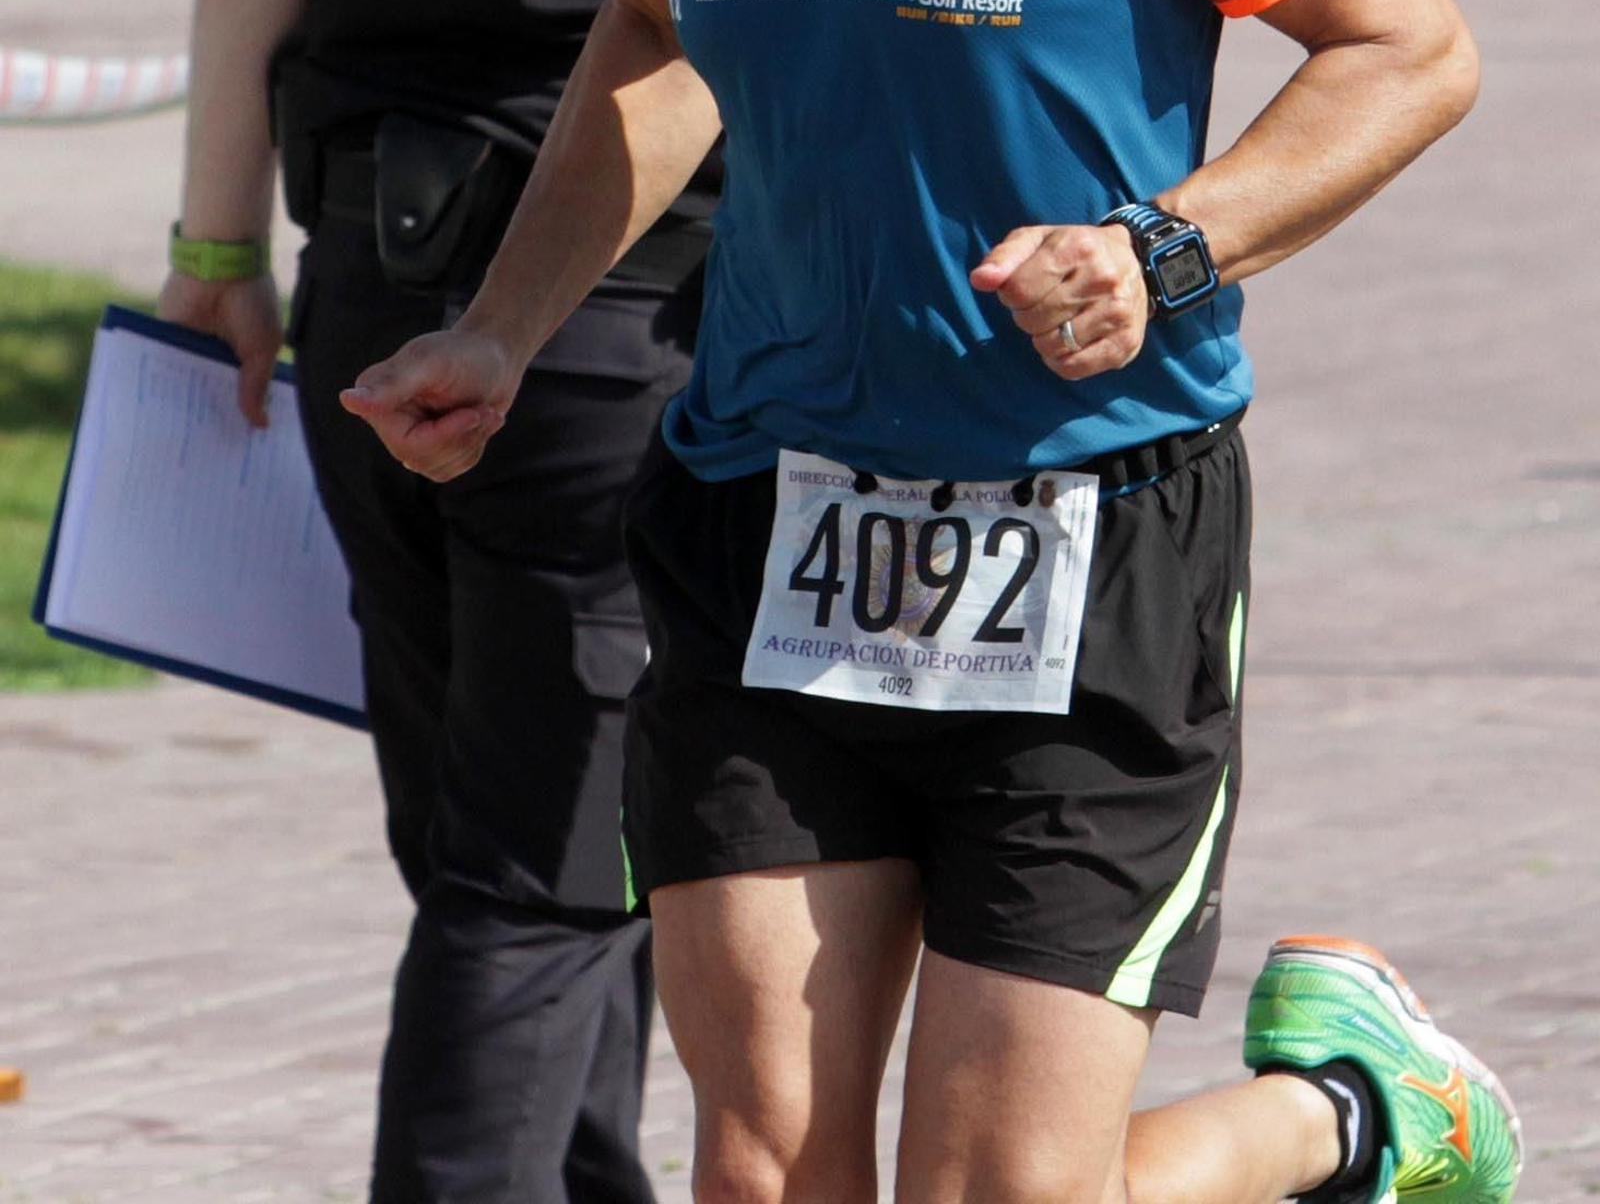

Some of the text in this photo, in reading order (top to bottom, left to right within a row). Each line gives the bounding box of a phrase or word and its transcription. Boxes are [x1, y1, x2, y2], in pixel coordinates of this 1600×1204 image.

[788, 502, 1041, 643] 4092
[761, 635, 1034, 672] AGRUPACIÓN DEPORTIVA
[1043, 656, 1066, 670] 4092
[878, 676, 913, 696] 4092
